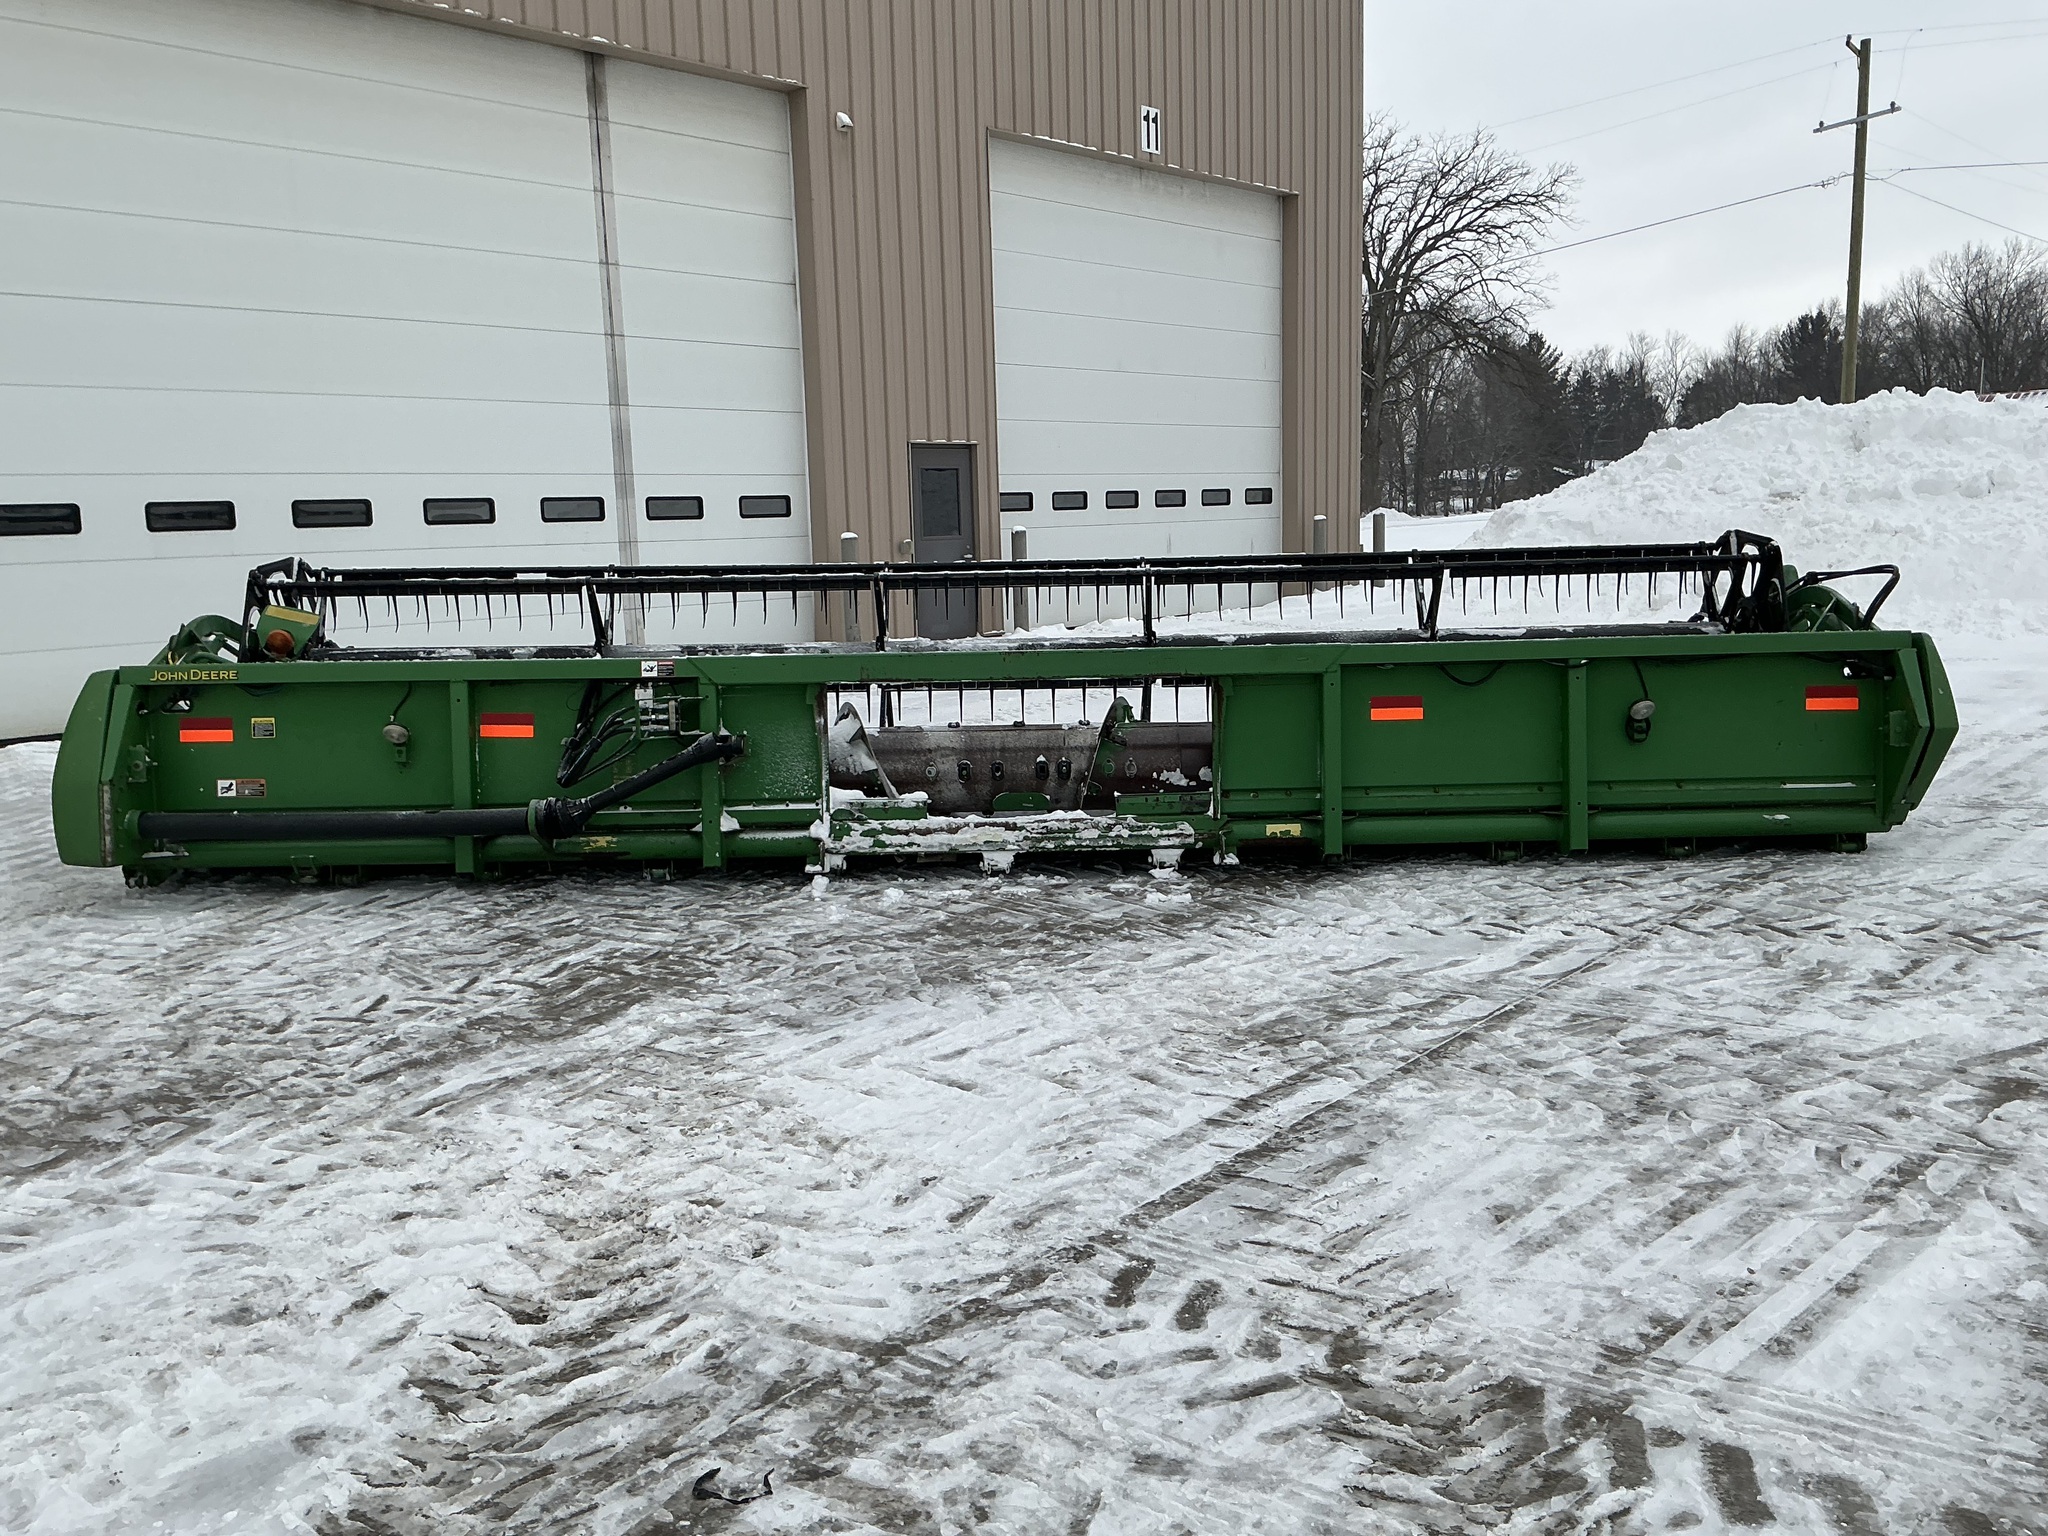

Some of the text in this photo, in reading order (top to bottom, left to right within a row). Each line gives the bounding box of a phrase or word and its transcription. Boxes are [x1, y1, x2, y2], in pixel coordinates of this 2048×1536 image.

[1143, 109, 1159, 151] 11
[149, 669, 238, 681] JOHN DEERE
